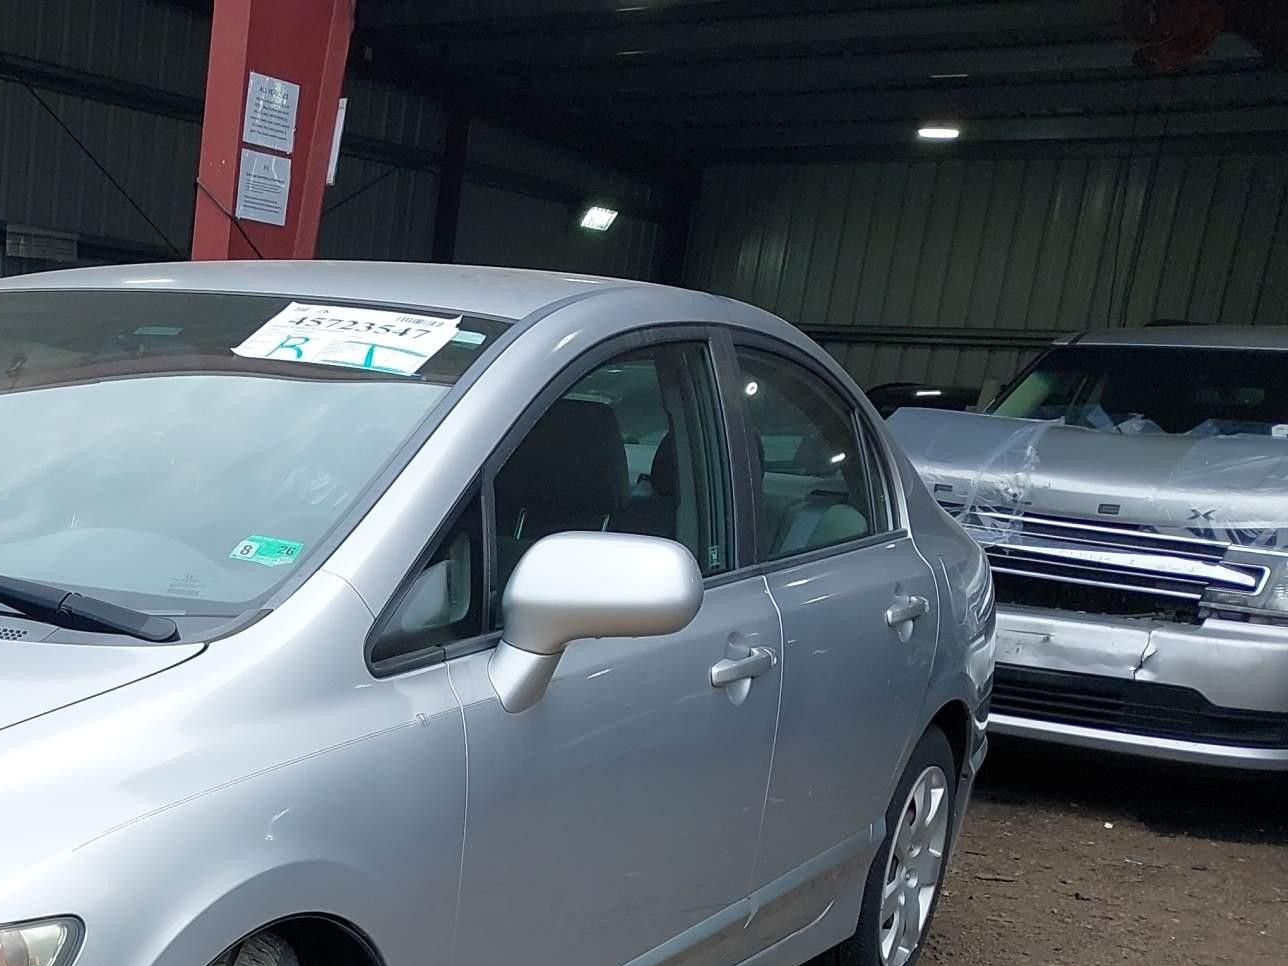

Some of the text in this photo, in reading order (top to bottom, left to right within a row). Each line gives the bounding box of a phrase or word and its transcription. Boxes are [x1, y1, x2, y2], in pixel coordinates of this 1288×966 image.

[289, 316, 431, 339] 45723547
[239, 544, 297, 556] 8 26
